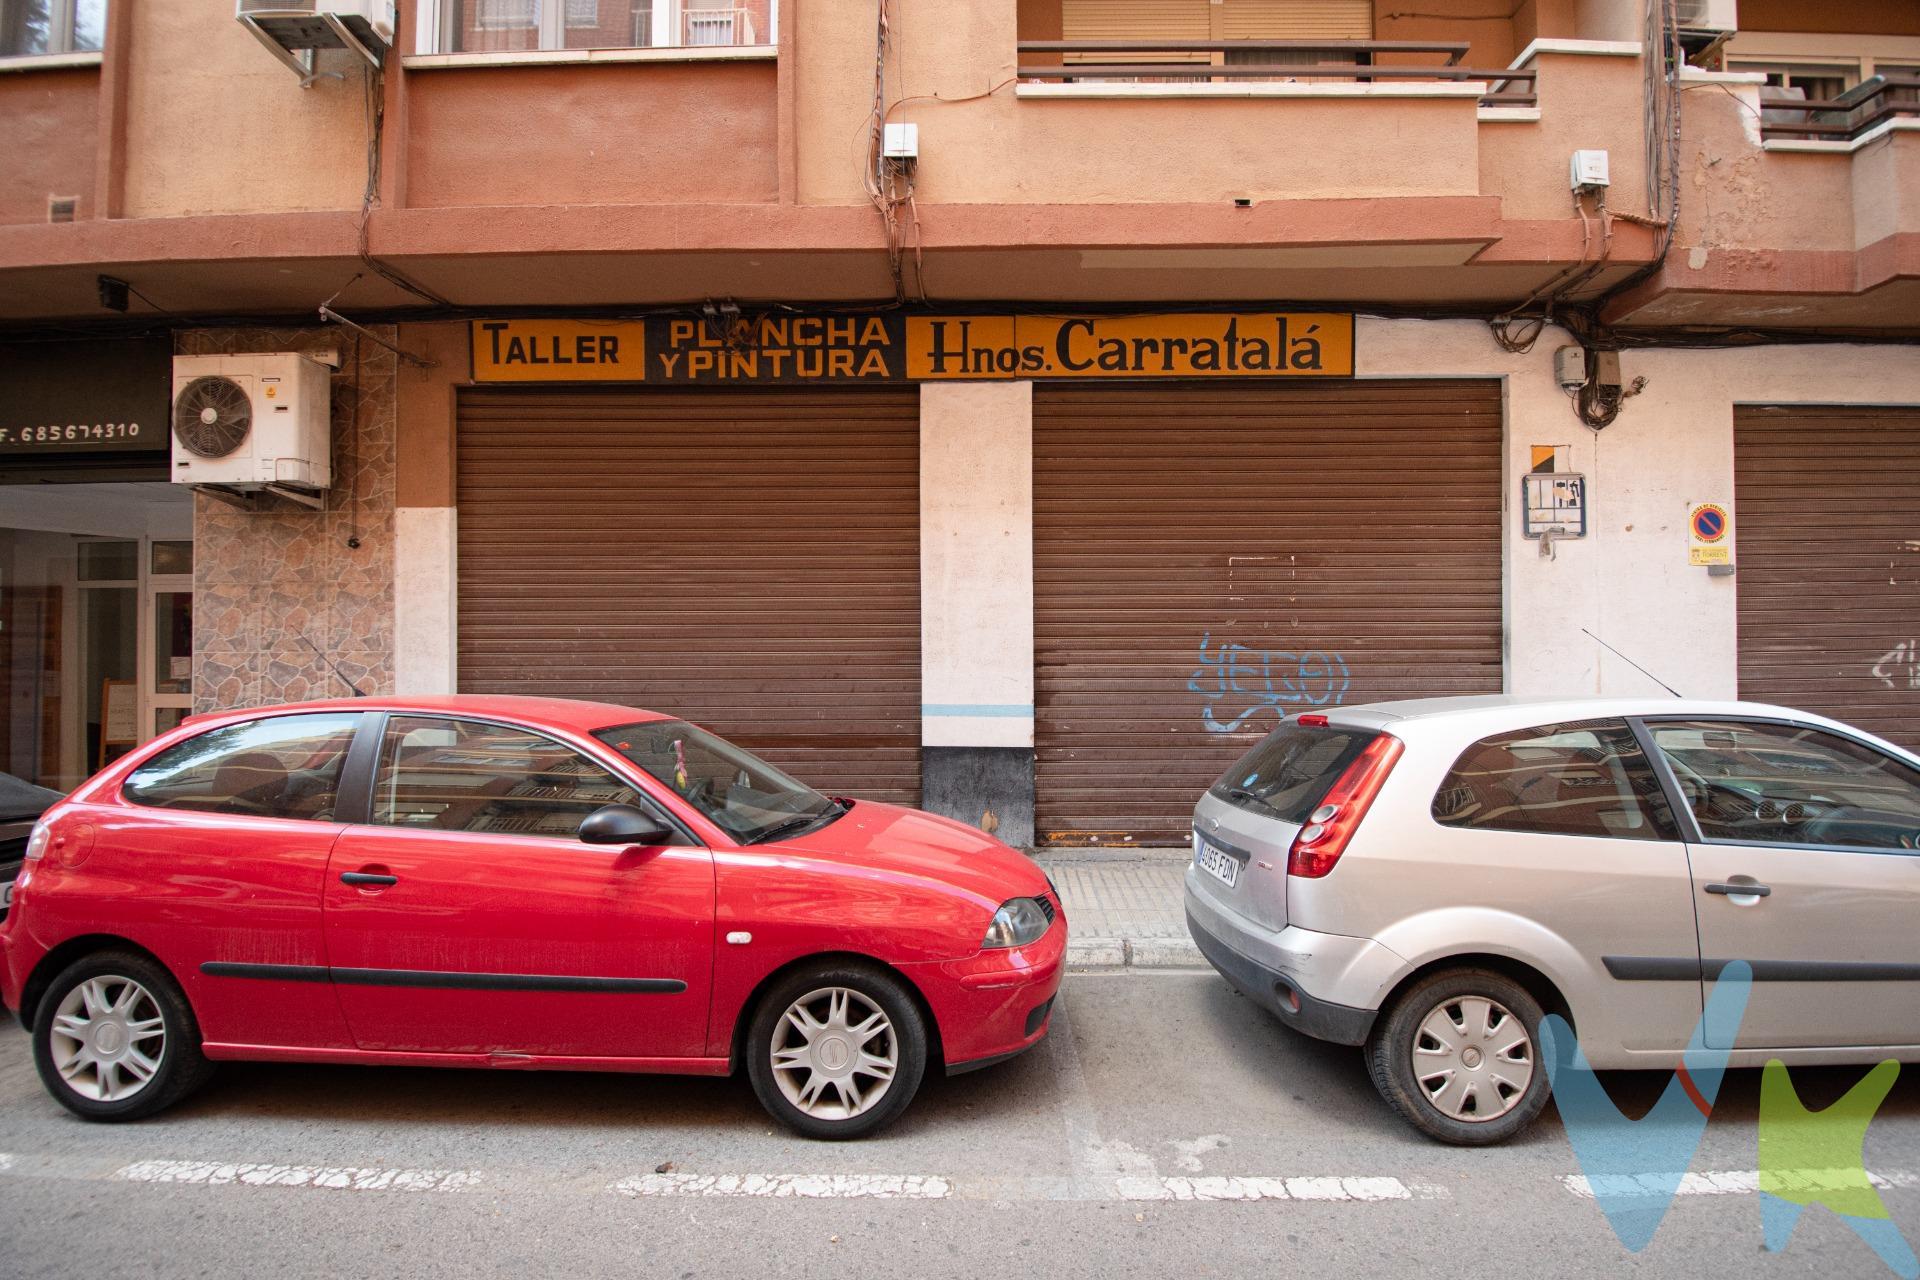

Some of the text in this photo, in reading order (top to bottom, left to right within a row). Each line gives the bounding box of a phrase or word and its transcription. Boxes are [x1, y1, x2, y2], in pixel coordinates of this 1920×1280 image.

[482, 322, 619, 365] TALLER
[670, 316, 890, 348] PLANCHA
[927, 317, 1323, 373] Hnos. Carratalá
[689, 348, 890, 379] PINTURA
[21, 422, 140, 442] 685674310
